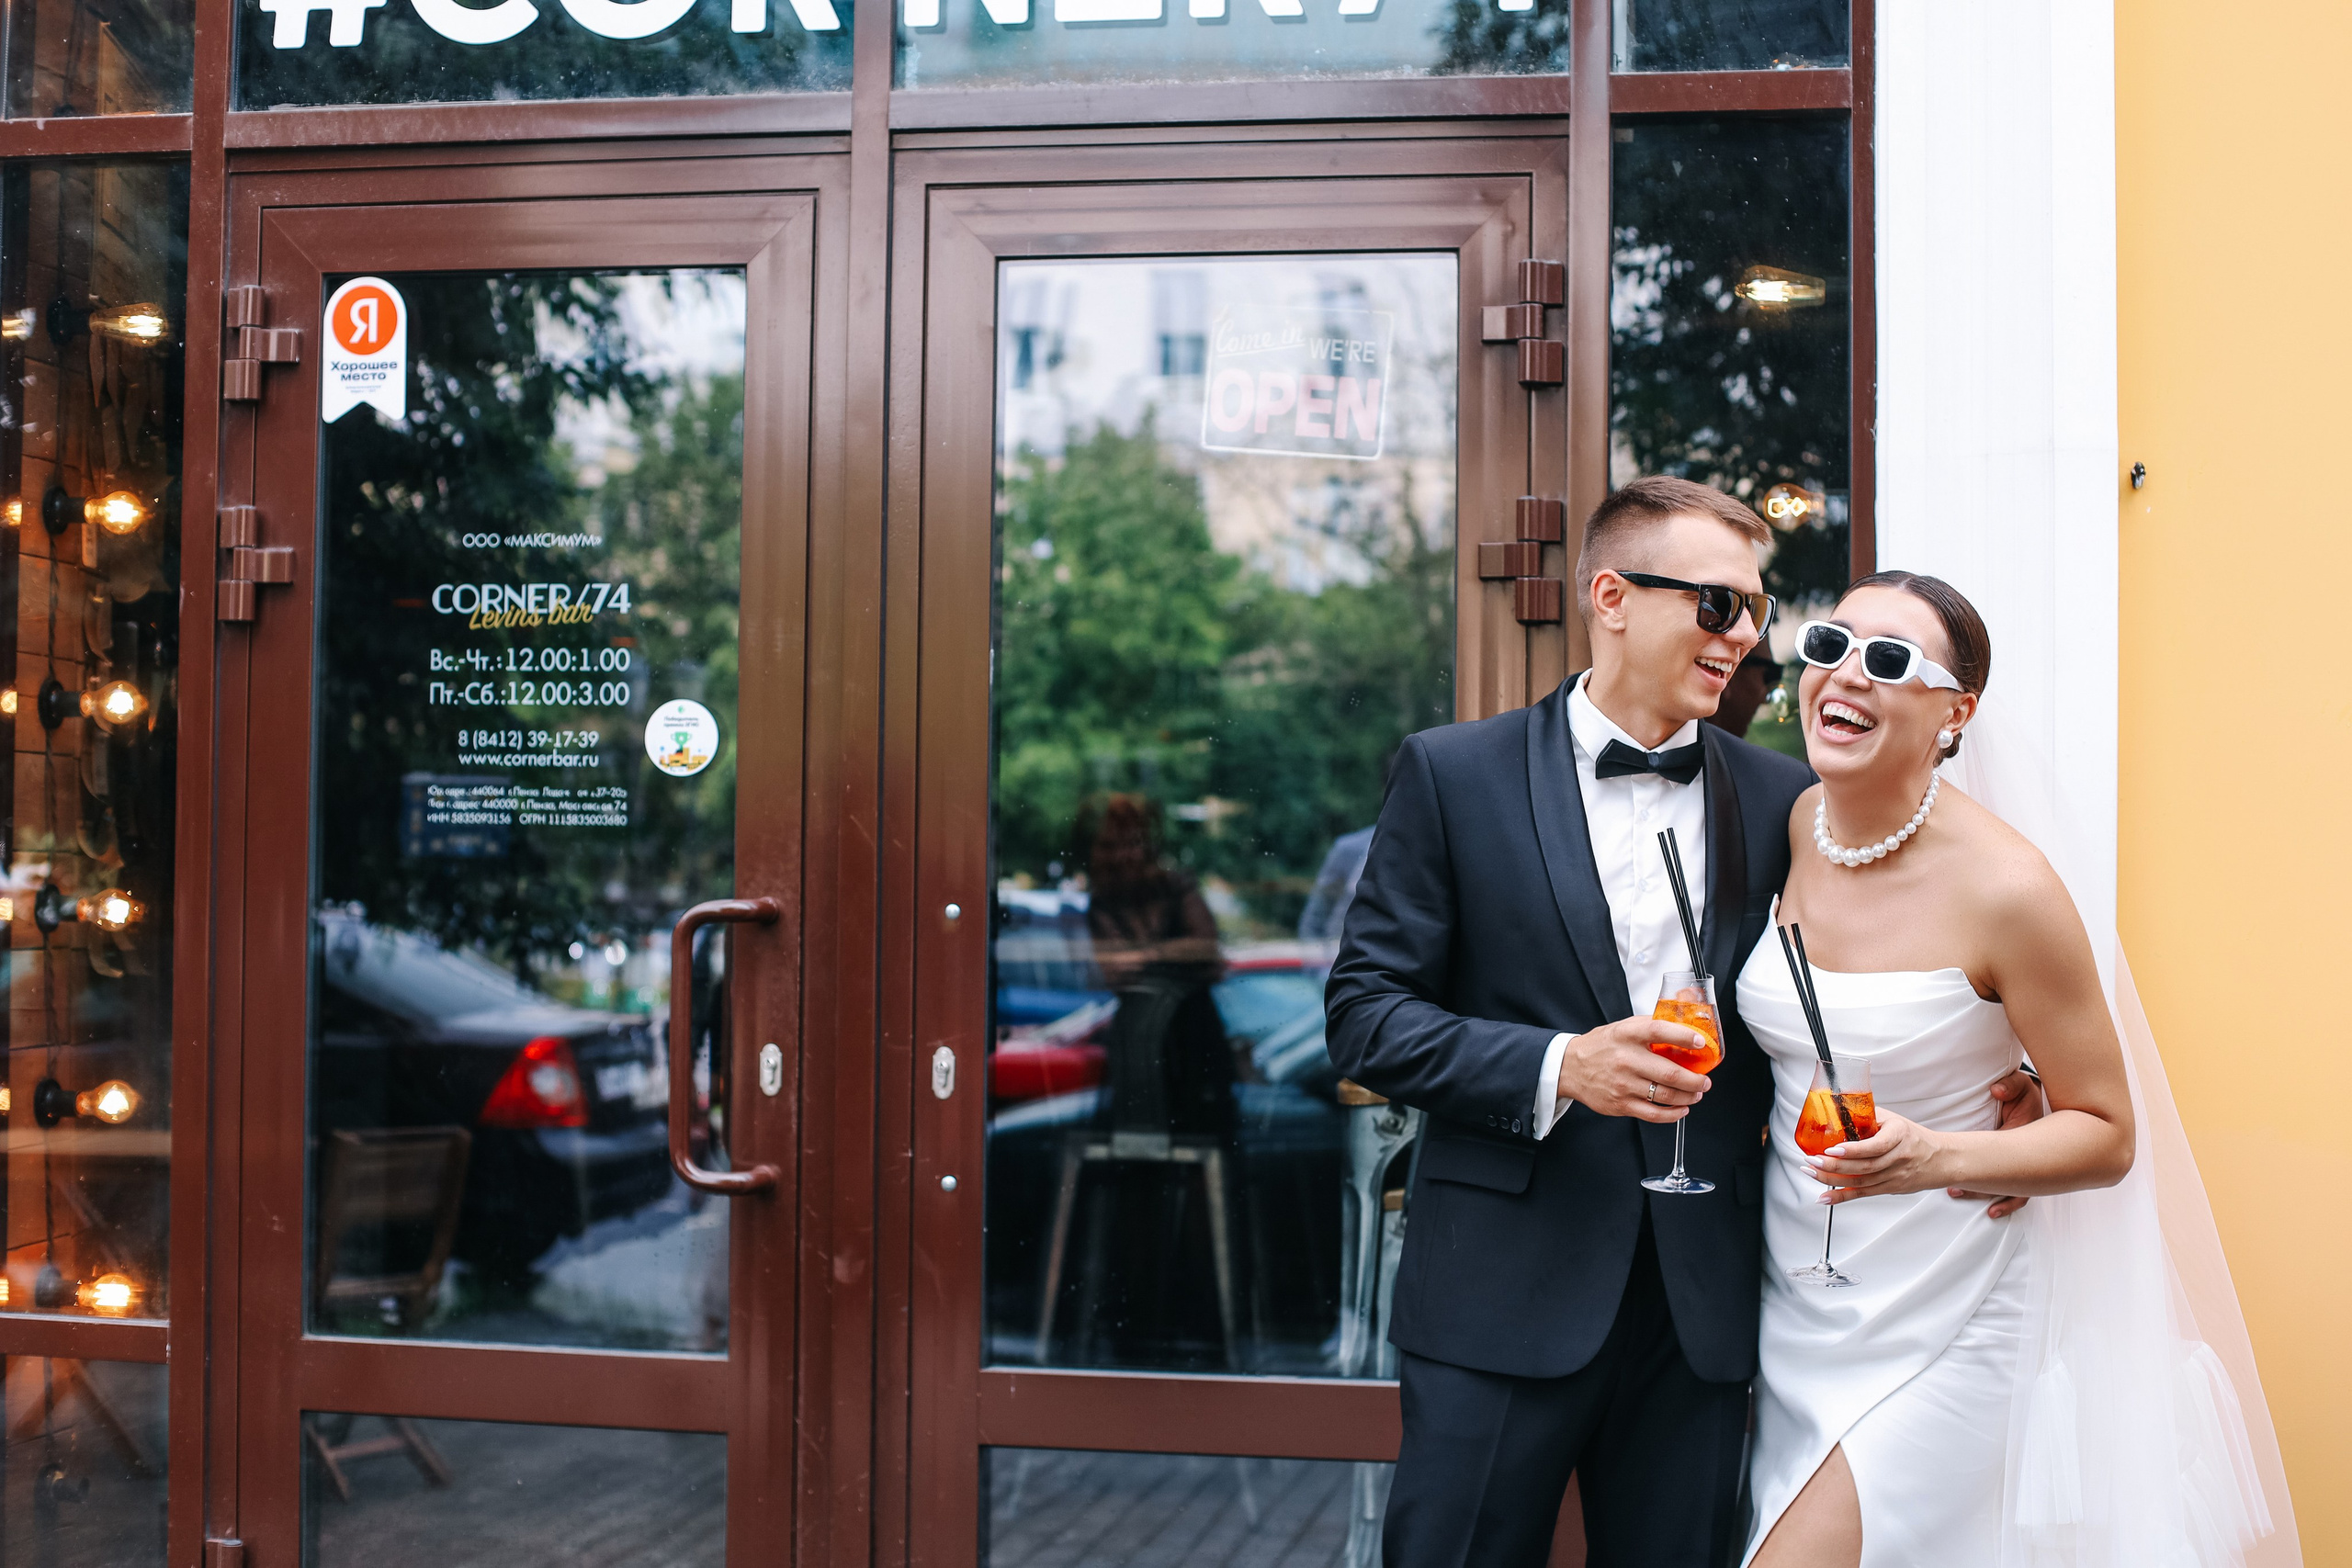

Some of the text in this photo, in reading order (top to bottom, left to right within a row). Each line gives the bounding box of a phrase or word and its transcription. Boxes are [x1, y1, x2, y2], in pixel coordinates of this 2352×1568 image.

[349, 298, 379, 344] Я
[1216, 318, 1376, 363] Come in WE'RE
[331, 361, 398, 372] Хорошее
[340, 372, 387, 381] место
[1210, 368, 1381, 441] OPEN
[462, 533, 501, 548] ООО
[432, 582, 632, 615] CORNER/74
[547, 595, 594, 625] bar
[458, 729, 600, 750] 8 (8412) 39-17-39
[458, 749, 599, 768] www.cornerbar.ru
[482, 798, 519, 810] 440000
[519, 812, 547, 825] ОГРН
